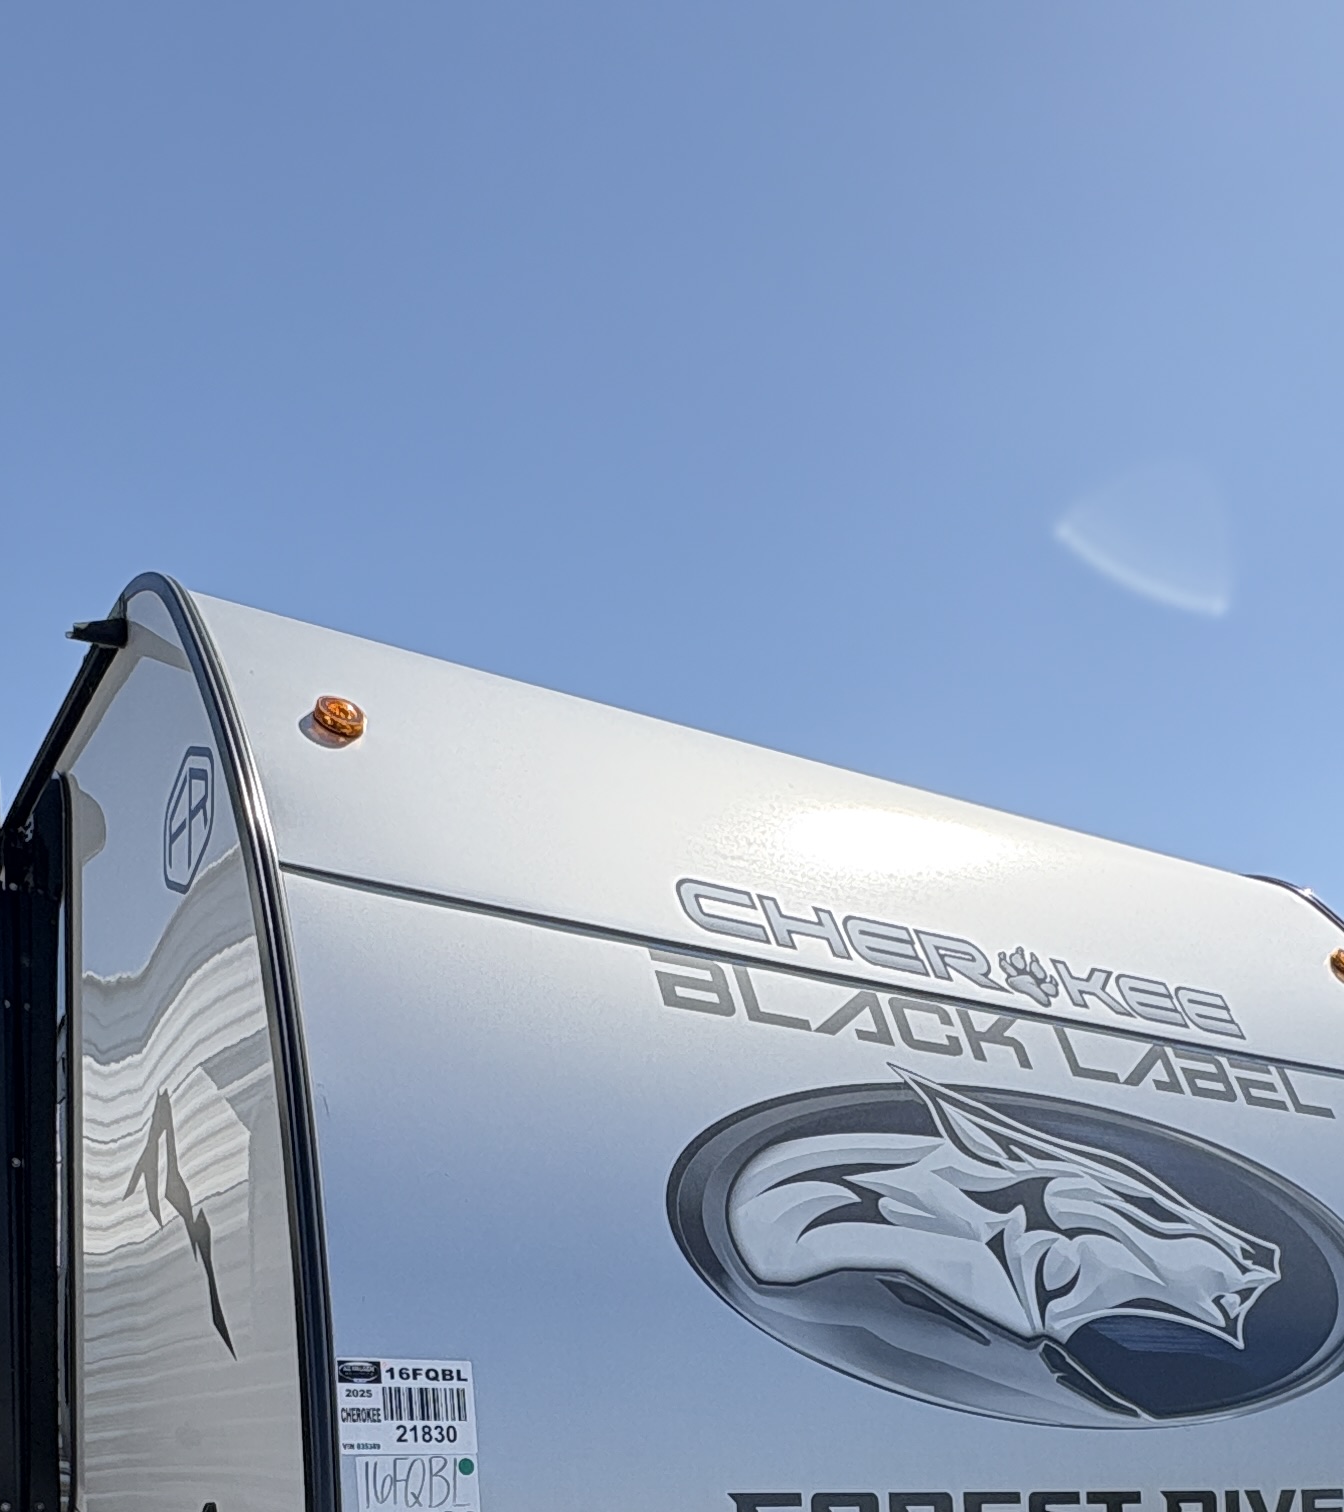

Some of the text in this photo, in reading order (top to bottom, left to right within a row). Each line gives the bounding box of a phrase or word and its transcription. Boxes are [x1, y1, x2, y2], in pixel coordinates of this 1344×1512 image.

[648, 948, 1337, 1119] BLACK LABEL
[385, 1367, 468, 1382] 16FQBL
[345, 1388, 373, 1398] 2025
[341, 1407, 382, 1423] CHEROKEE
[396, 1425, 458, 1443] 21830
[364, 1455, 471, 1509] 16FQBL
